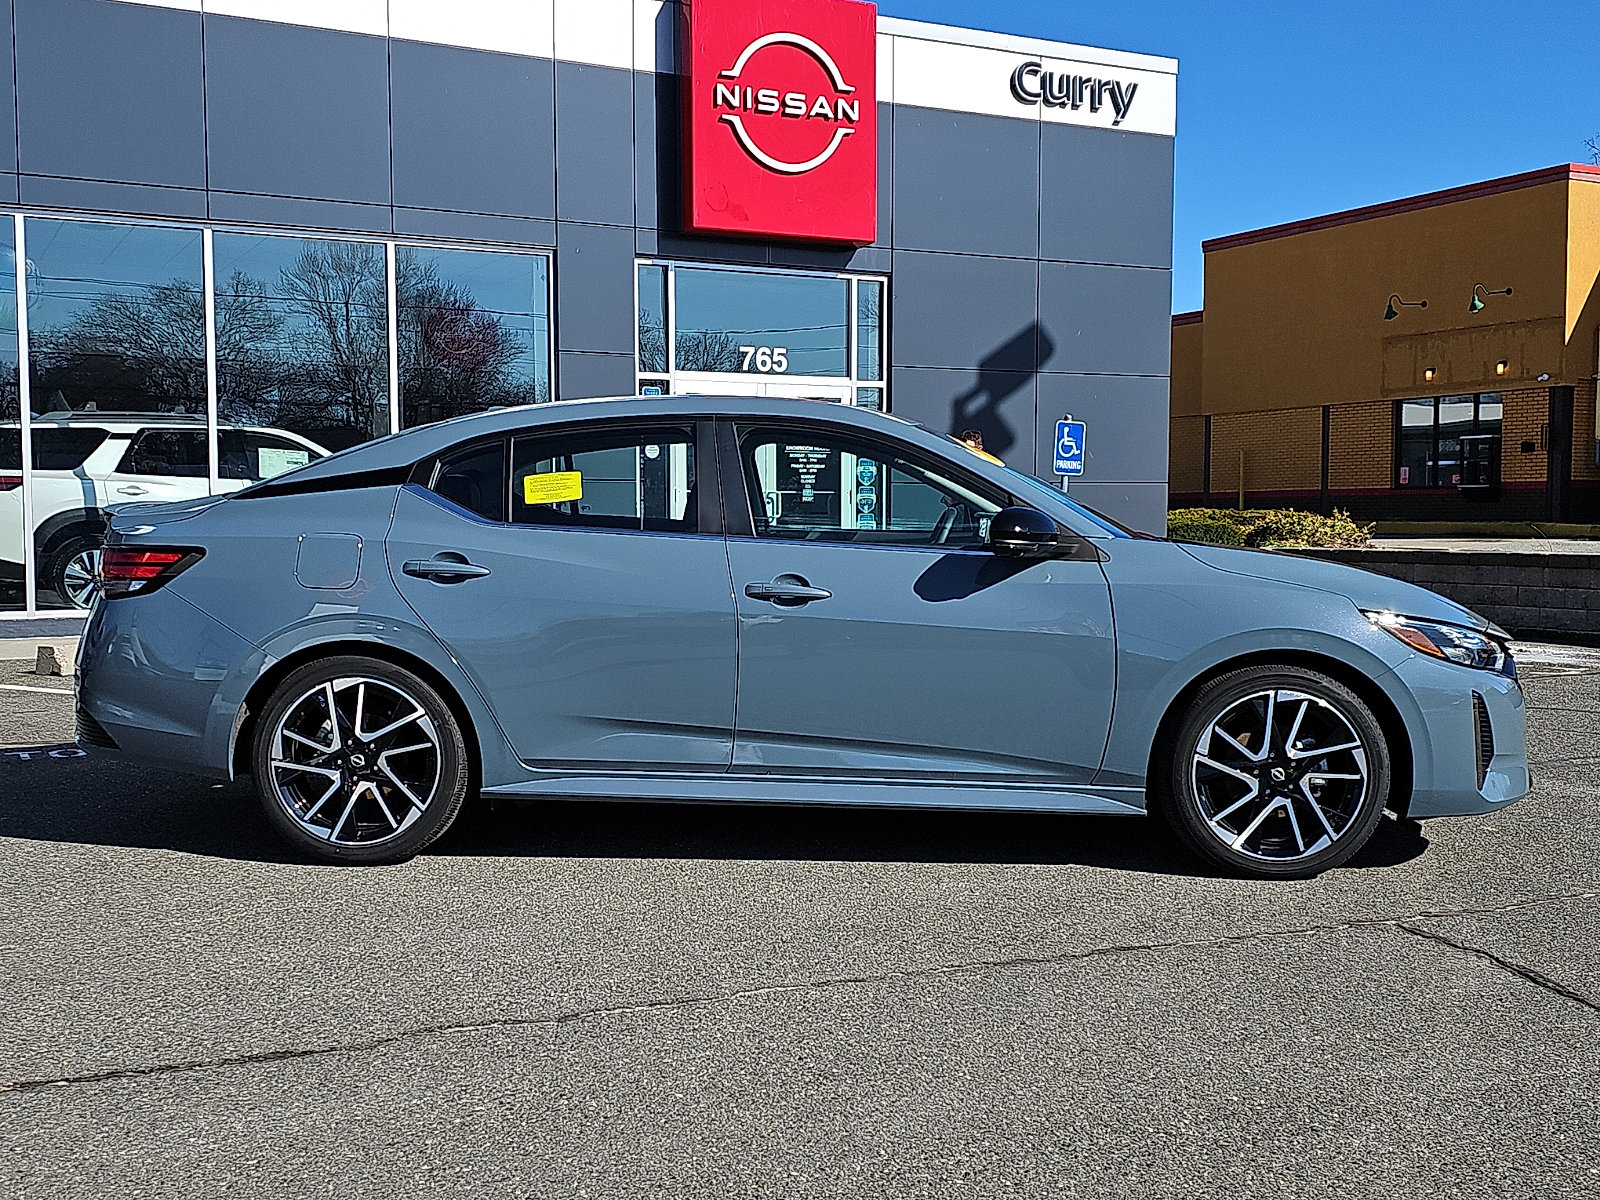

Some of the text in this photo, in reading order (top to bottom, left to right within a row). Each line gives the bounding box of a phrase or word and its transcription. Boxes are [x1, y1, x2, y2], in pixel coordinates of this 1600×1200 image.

[714, 82, 860, 123] NISSAN
[1010, 61, 1139, 126] Curry
[739, 346, 788, 373] 765
[1056, 459, 1082, 470] PARKING
